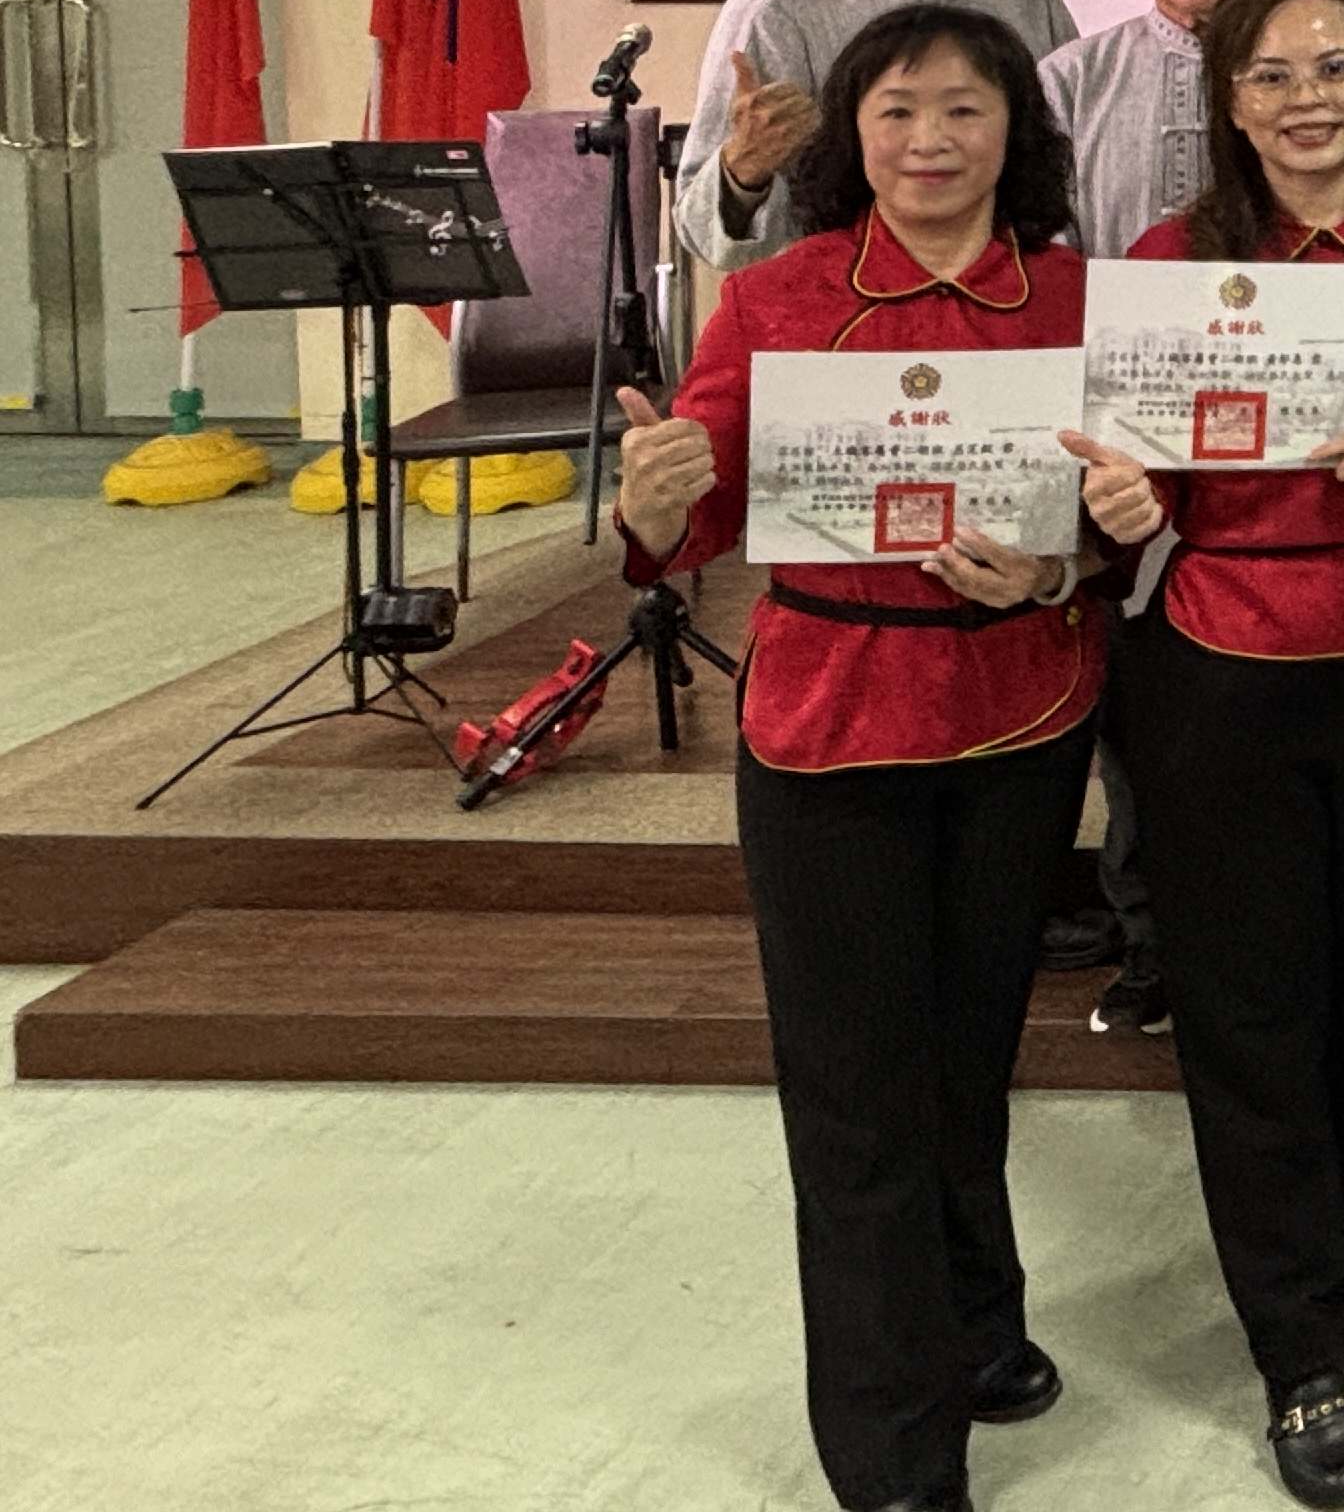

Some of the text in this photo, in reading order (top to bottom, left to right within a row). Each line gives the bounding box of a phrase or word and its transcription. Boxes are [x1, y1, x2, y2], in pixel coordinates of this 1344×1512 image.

[1206, 318, 1266, 336] 感謝狀
[888, 409, 951, 428] 感謝狀
